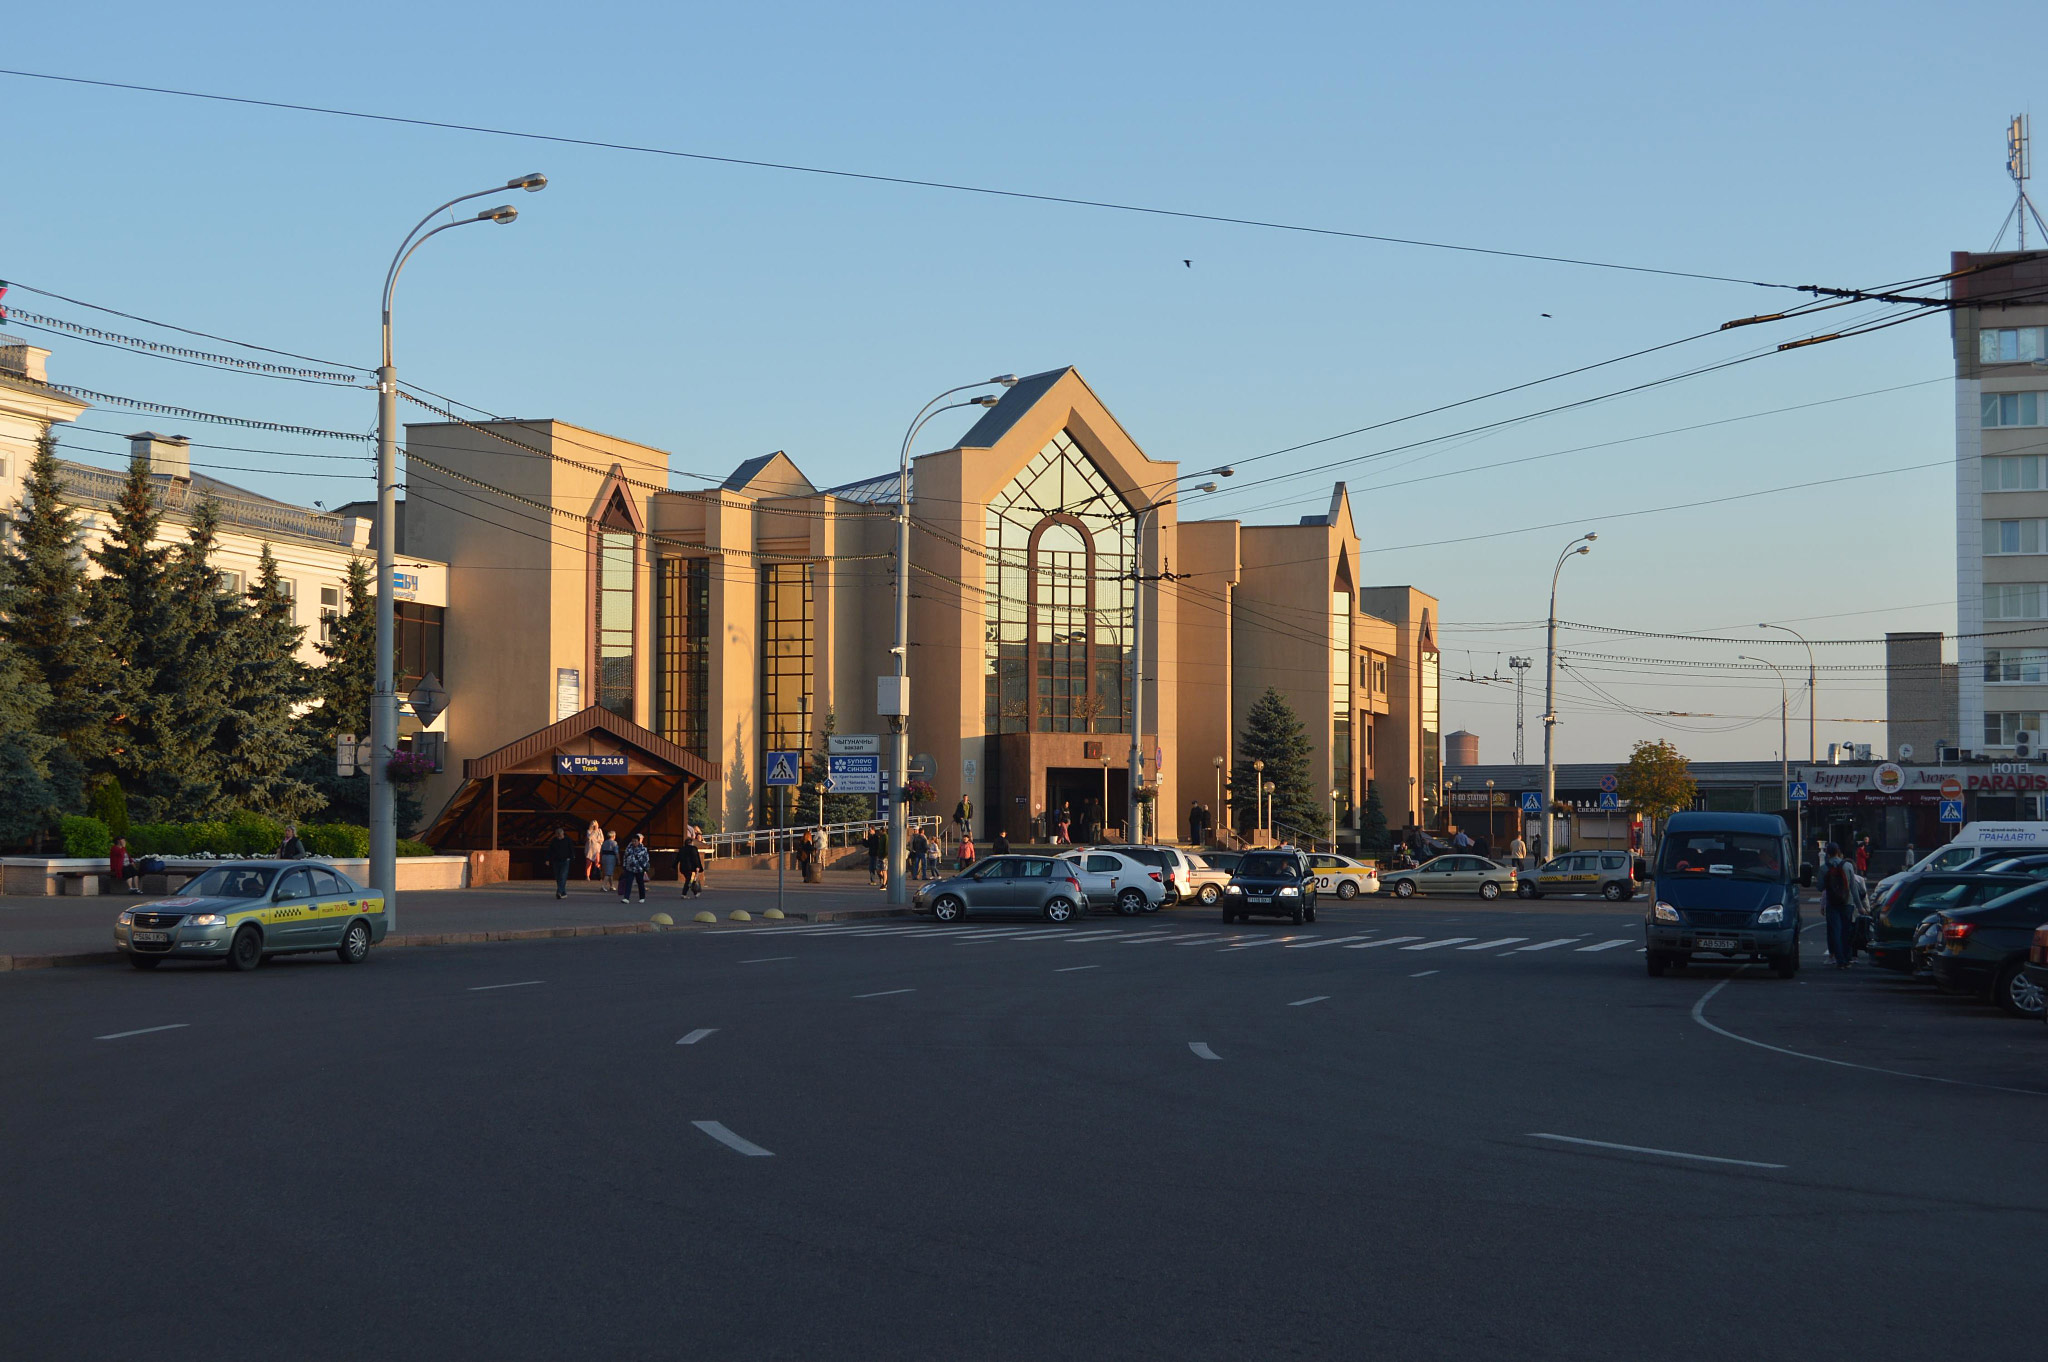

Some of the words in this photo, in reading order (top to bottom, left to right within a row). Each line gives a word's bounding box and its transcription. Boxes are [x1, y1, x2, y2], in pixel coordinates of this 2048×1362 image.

[582, 758, 600, 766] Пуць
[602, 758, 624, 766] 2,3,5,6
[1991, 762, 2032, 774] HOTEL
[1815, 770, 1866, 788] Бургер
[1467, 793, 1488, 801] STATION
[1978, 833, 2036, 841] ГРАНДАВТО
